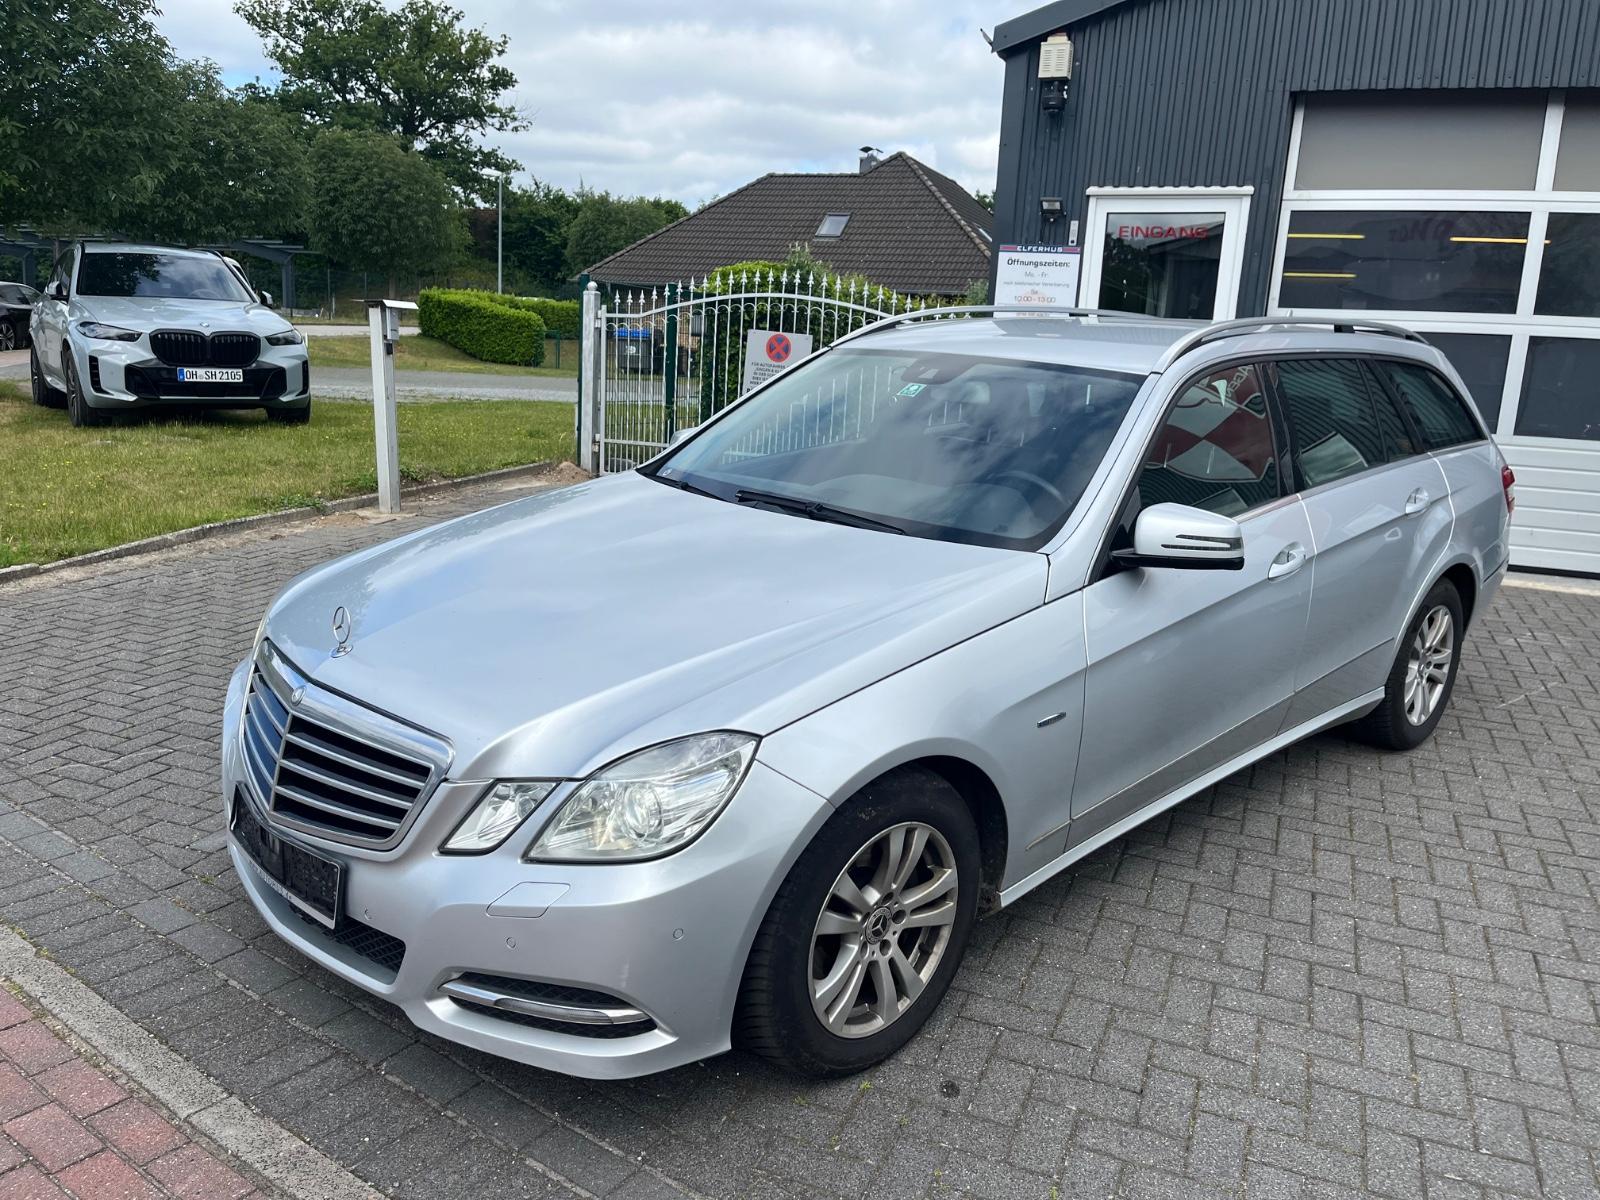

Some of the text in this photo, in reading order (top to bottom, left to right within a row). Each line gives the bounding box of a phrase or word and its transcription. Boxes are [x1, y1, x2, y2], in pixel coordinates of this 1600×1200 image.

[1118, 225, 1209, 239] EINGANG
[1007, 258, 1071, 268] Öffnungszeiten:
[185, 370, 242, 381] OH SH 2105
